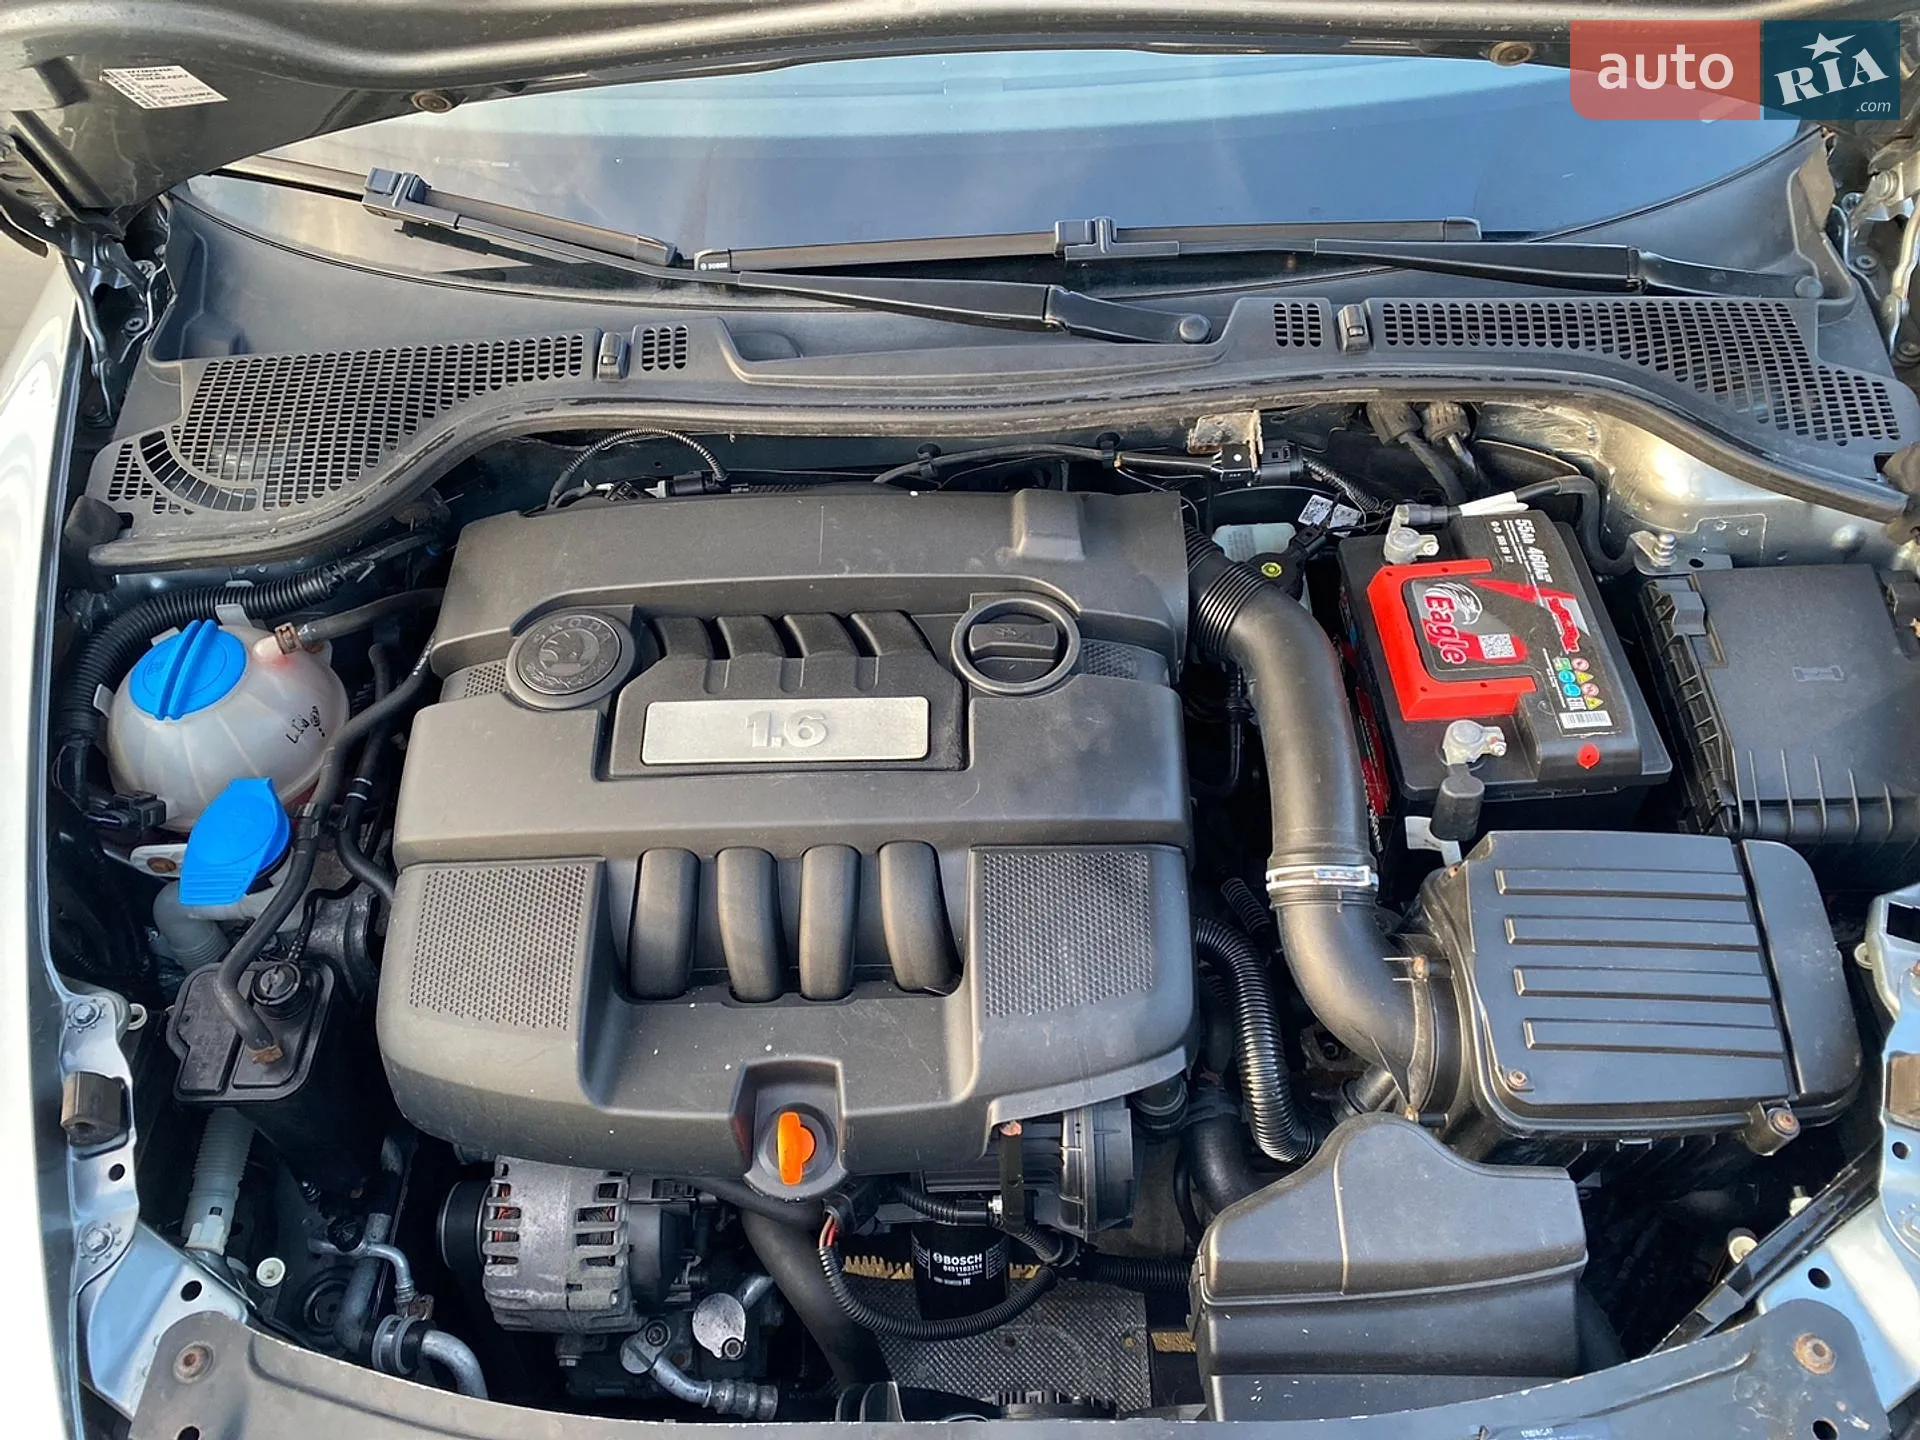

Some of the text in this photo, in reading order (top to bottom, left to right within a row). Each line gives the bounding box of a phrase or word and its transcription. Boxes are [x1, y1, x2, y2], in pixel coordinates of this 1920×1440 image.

[1423, 592, 1469, 664] Eagle
[745, 710, 829, 748] 1.6
[943, 1253, 983, 1266] BOSCH
